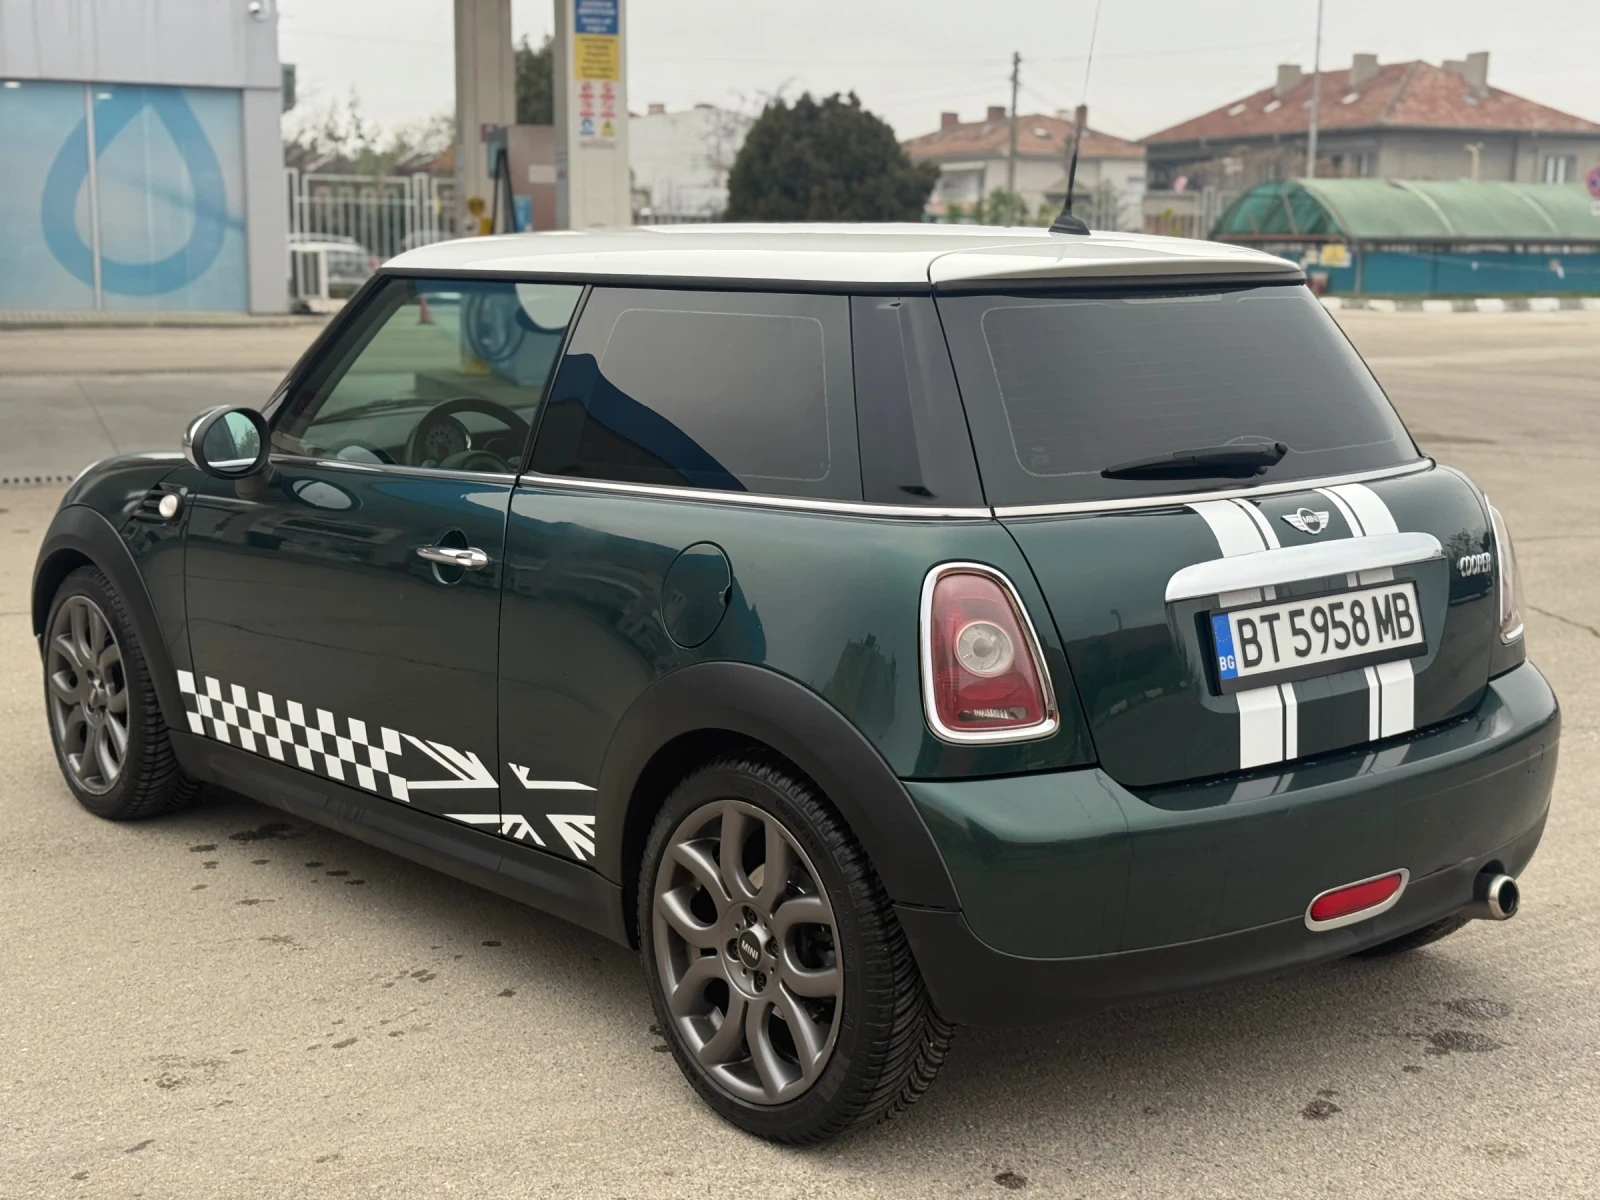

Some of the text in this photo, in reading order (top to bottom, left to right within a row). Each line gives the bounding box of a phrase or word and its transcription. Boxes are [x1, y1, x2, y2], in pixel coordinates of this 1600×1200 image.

[1302, 515, 1319, 523] MINI
[1460, 552, 1491, 577] COOPER
[1237, 592, 1414, 669] BT 5958 MB
[1219, 655, 1235, 671] BG
[741, 940, 758, 960] MINI
